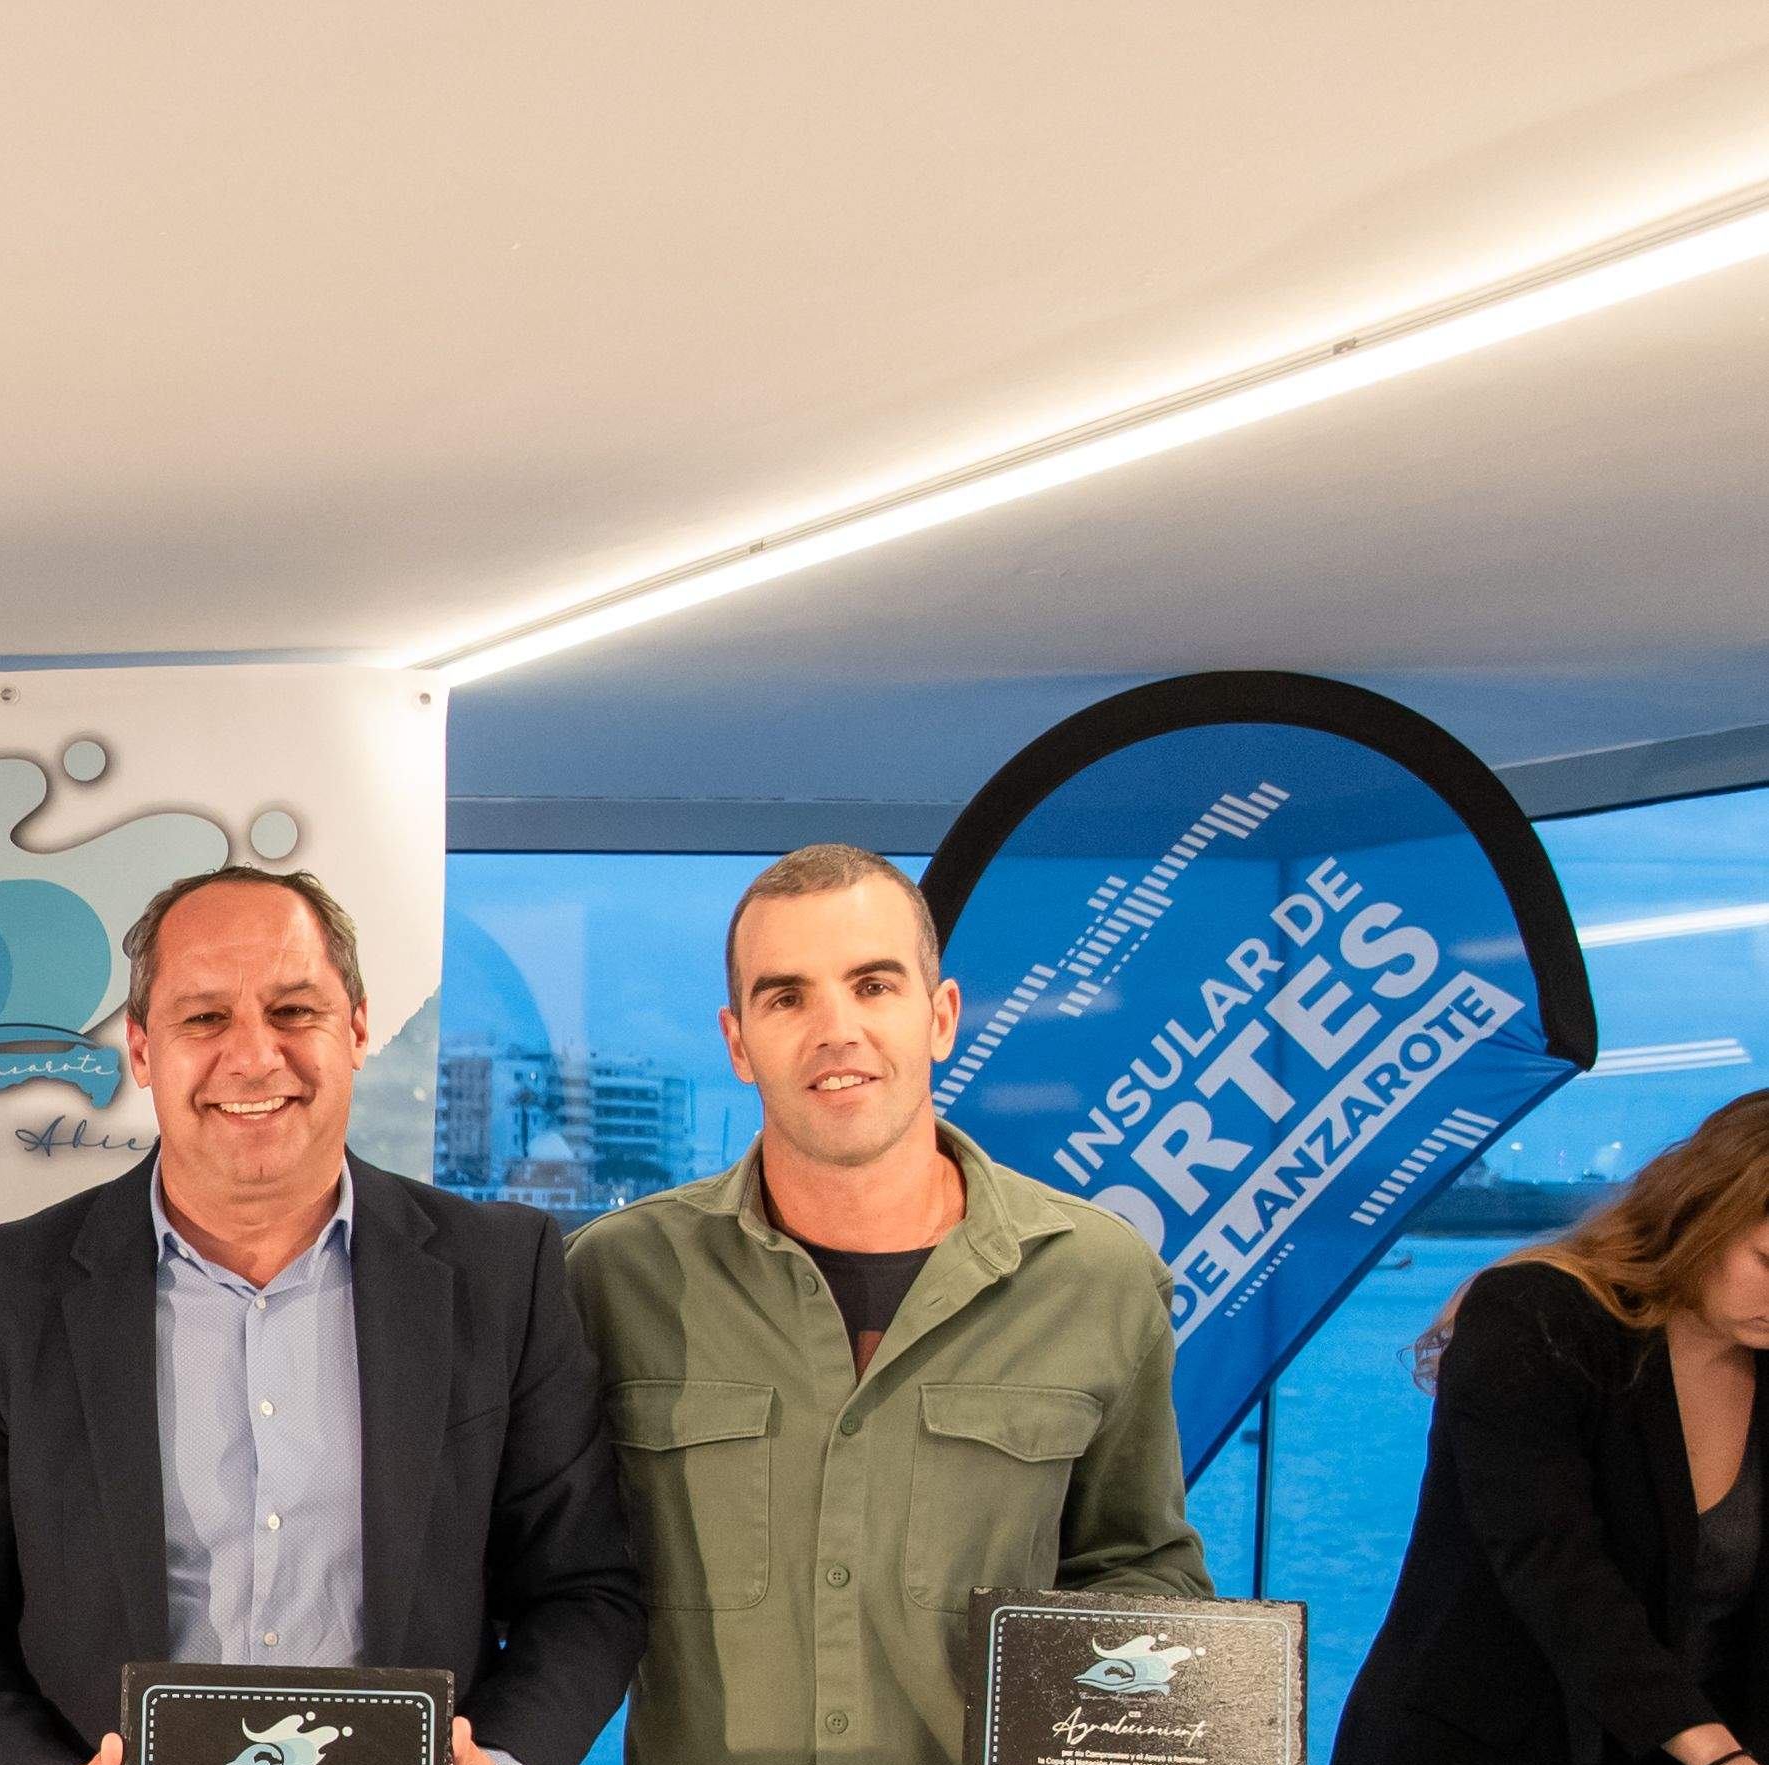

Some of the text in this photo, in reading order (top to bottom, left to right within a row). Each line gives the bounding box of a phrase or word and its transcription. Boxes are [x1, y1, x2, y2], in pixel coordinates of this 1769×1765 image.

[1053, 856, 1363, 1187] INSULAR DE
[1171, 985, 1496, 1331] DE LANZAROTE
